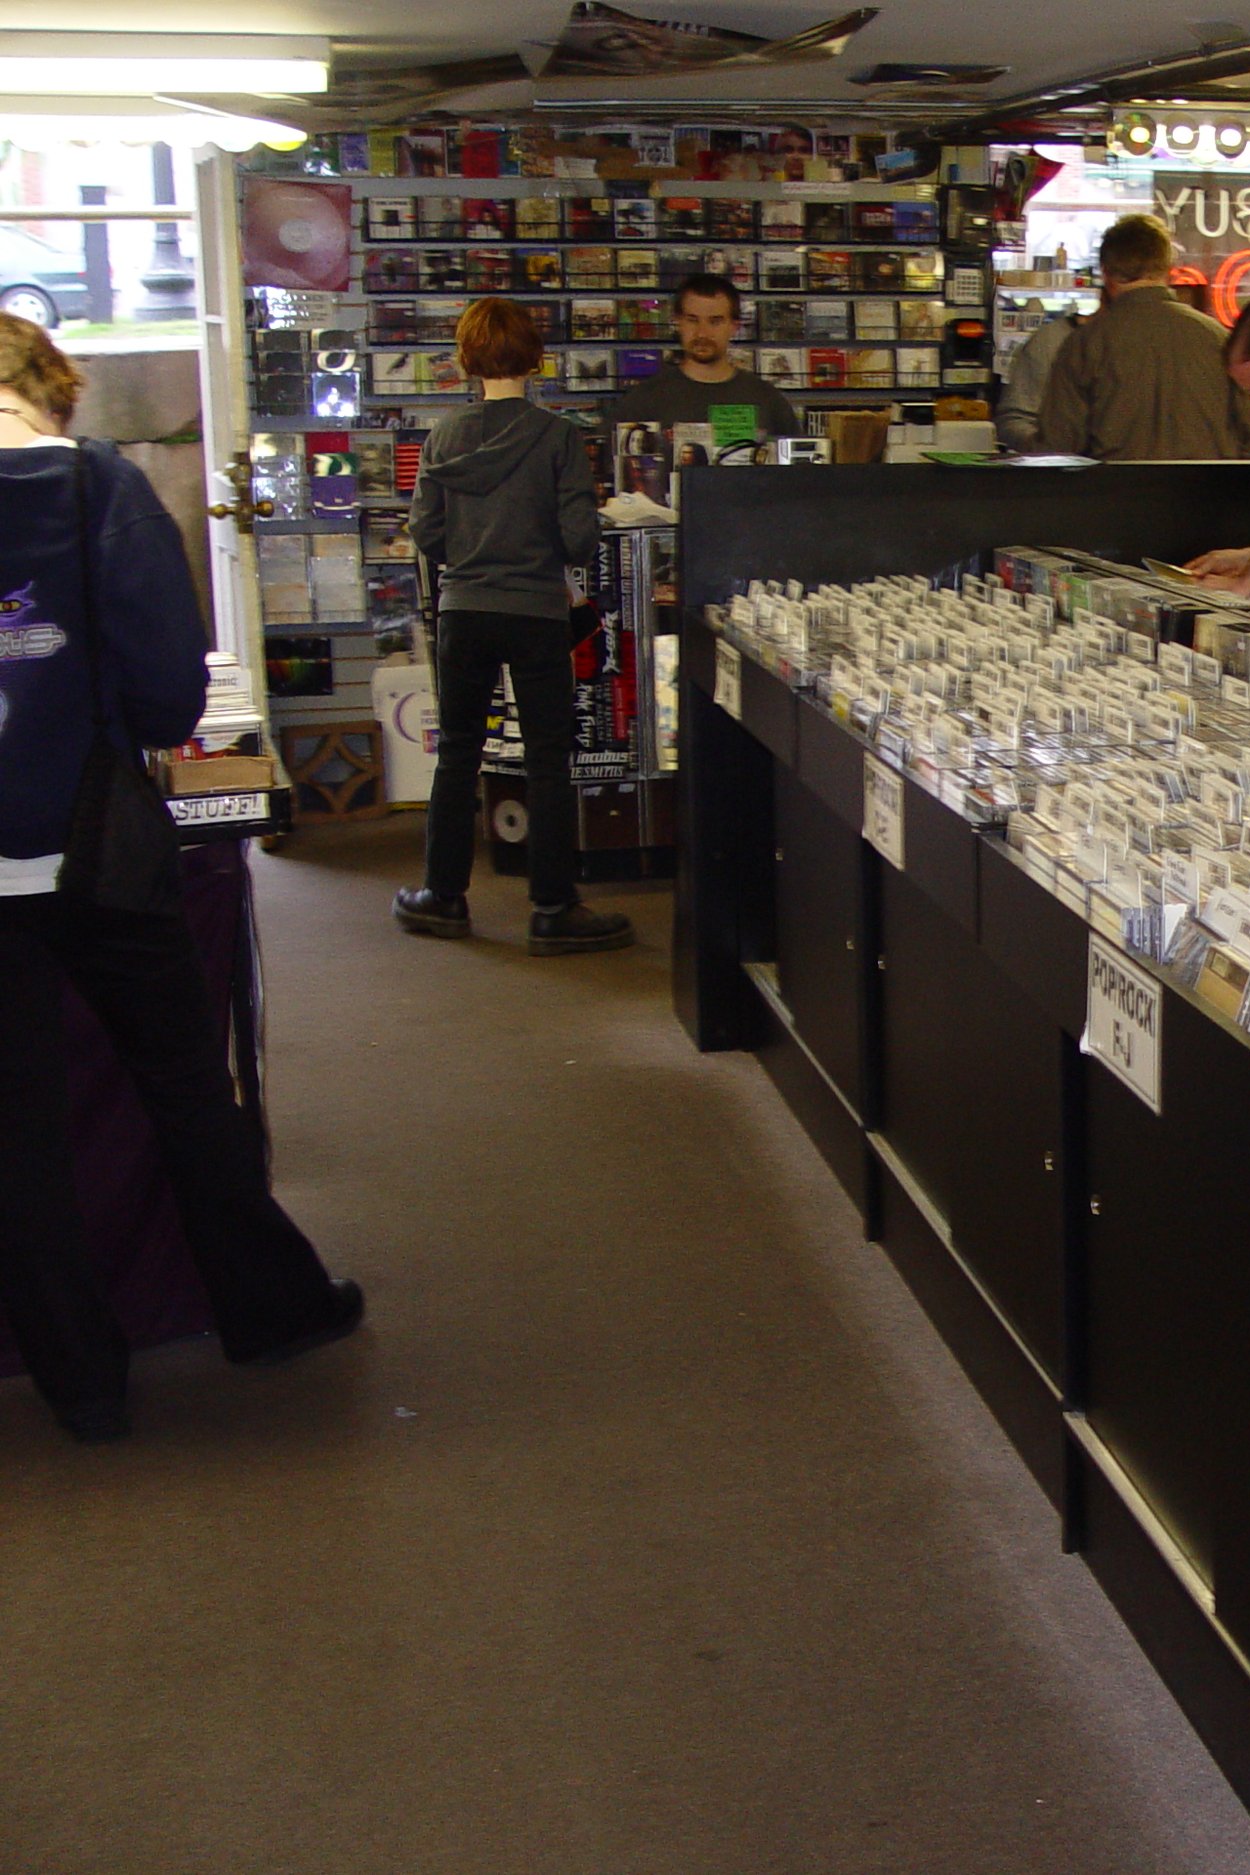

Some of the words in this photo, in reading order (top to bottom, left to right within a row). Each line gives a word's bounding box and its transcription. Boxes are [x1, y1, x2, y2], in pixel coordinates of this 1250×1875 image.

[598, 541, 610, 591] AVAIL
[576, 749, 629, 764] incubus
[175, 796, 258, 821] STUFF!
[1092, 950, 1155, 1038] POP/ROCK
